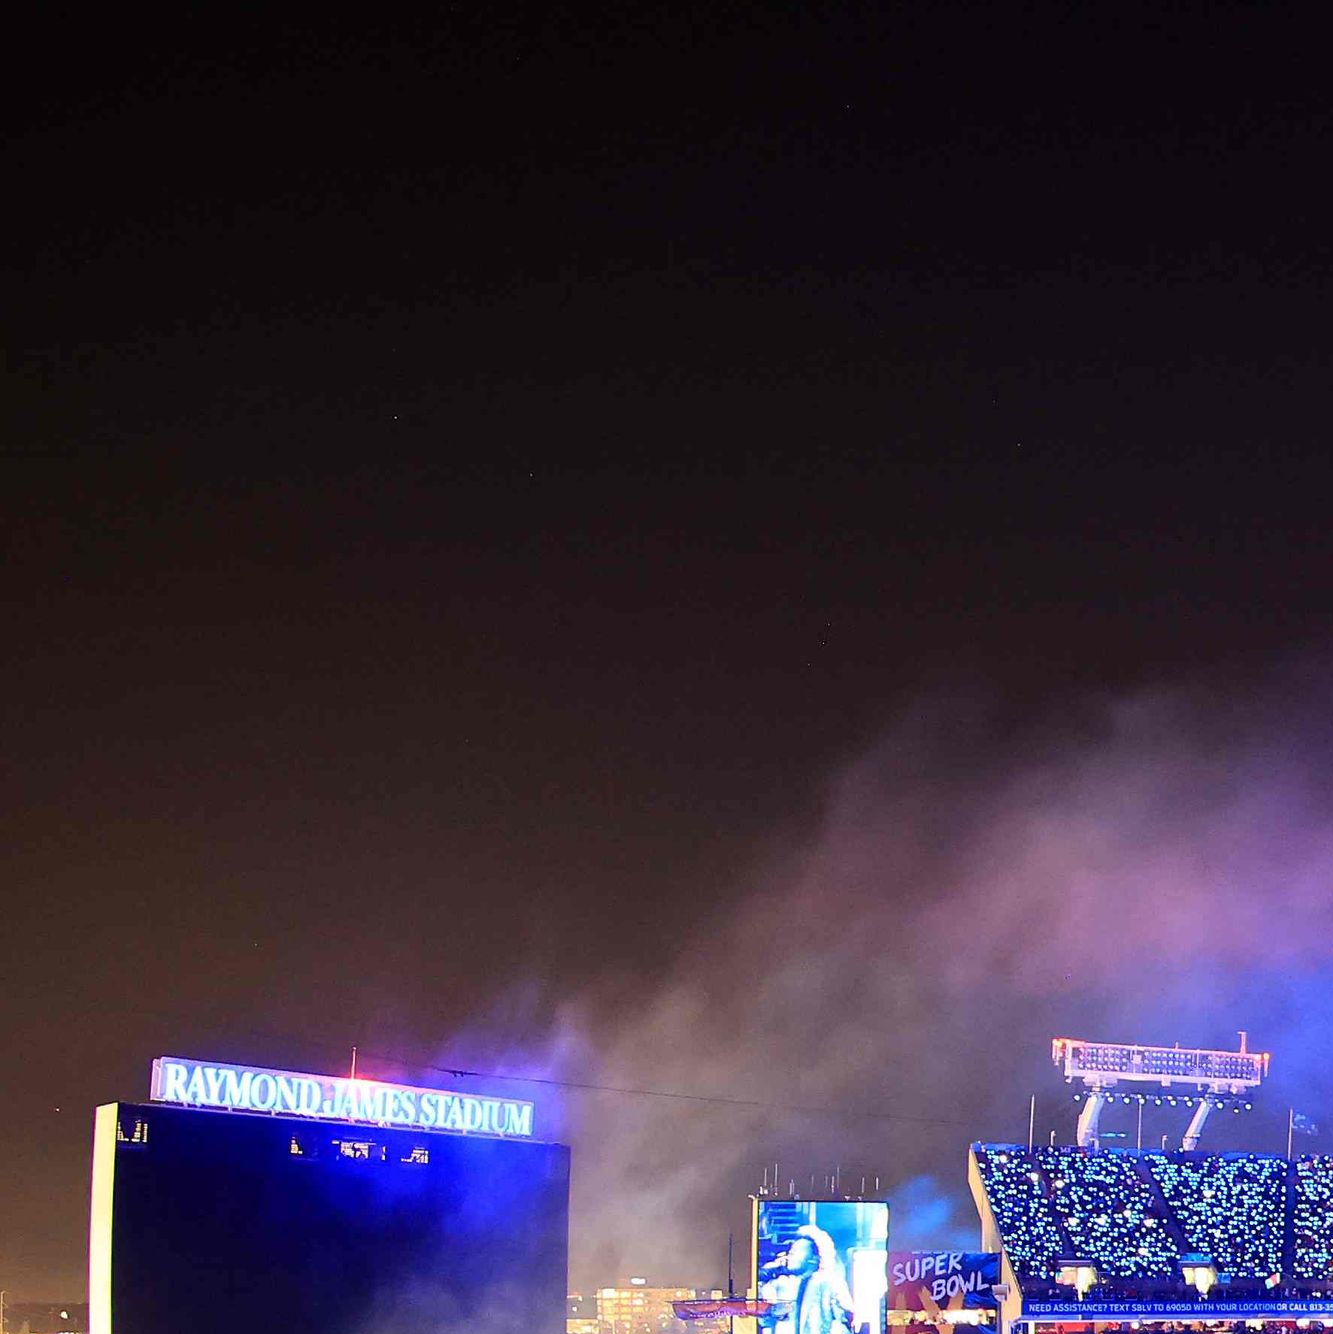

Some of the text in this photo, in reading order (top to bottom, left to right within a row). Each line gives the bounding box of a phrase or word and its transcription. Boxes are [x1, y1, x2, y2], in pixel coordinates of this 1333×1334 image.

[165, 1064, 532, 1136] RAYMOND JAMES STADIUM
[893, 1252, 963, 1286] SUPER
[930, 1271, 990, 1301] BOWL
[1029, 1303, 1050, 1312] NEED
[1053, 1303, 1107, 1312] ASSISTANCE?
[1109, 1303, 1129, 1312] TEXT
[1132, 1303, 1151, 1312] SBLV
[1153, 1303, 1164, 1312] TO
[1194, 1303, 1214, 1312] WITH
[1216, 1303, 1237, 1312] YOUR
[1239, 1303, 1276, 1312] LOCATION
[1276, 1303, 1287, 1312] OR
[1289, 1303, 1307, 1312] CALL
